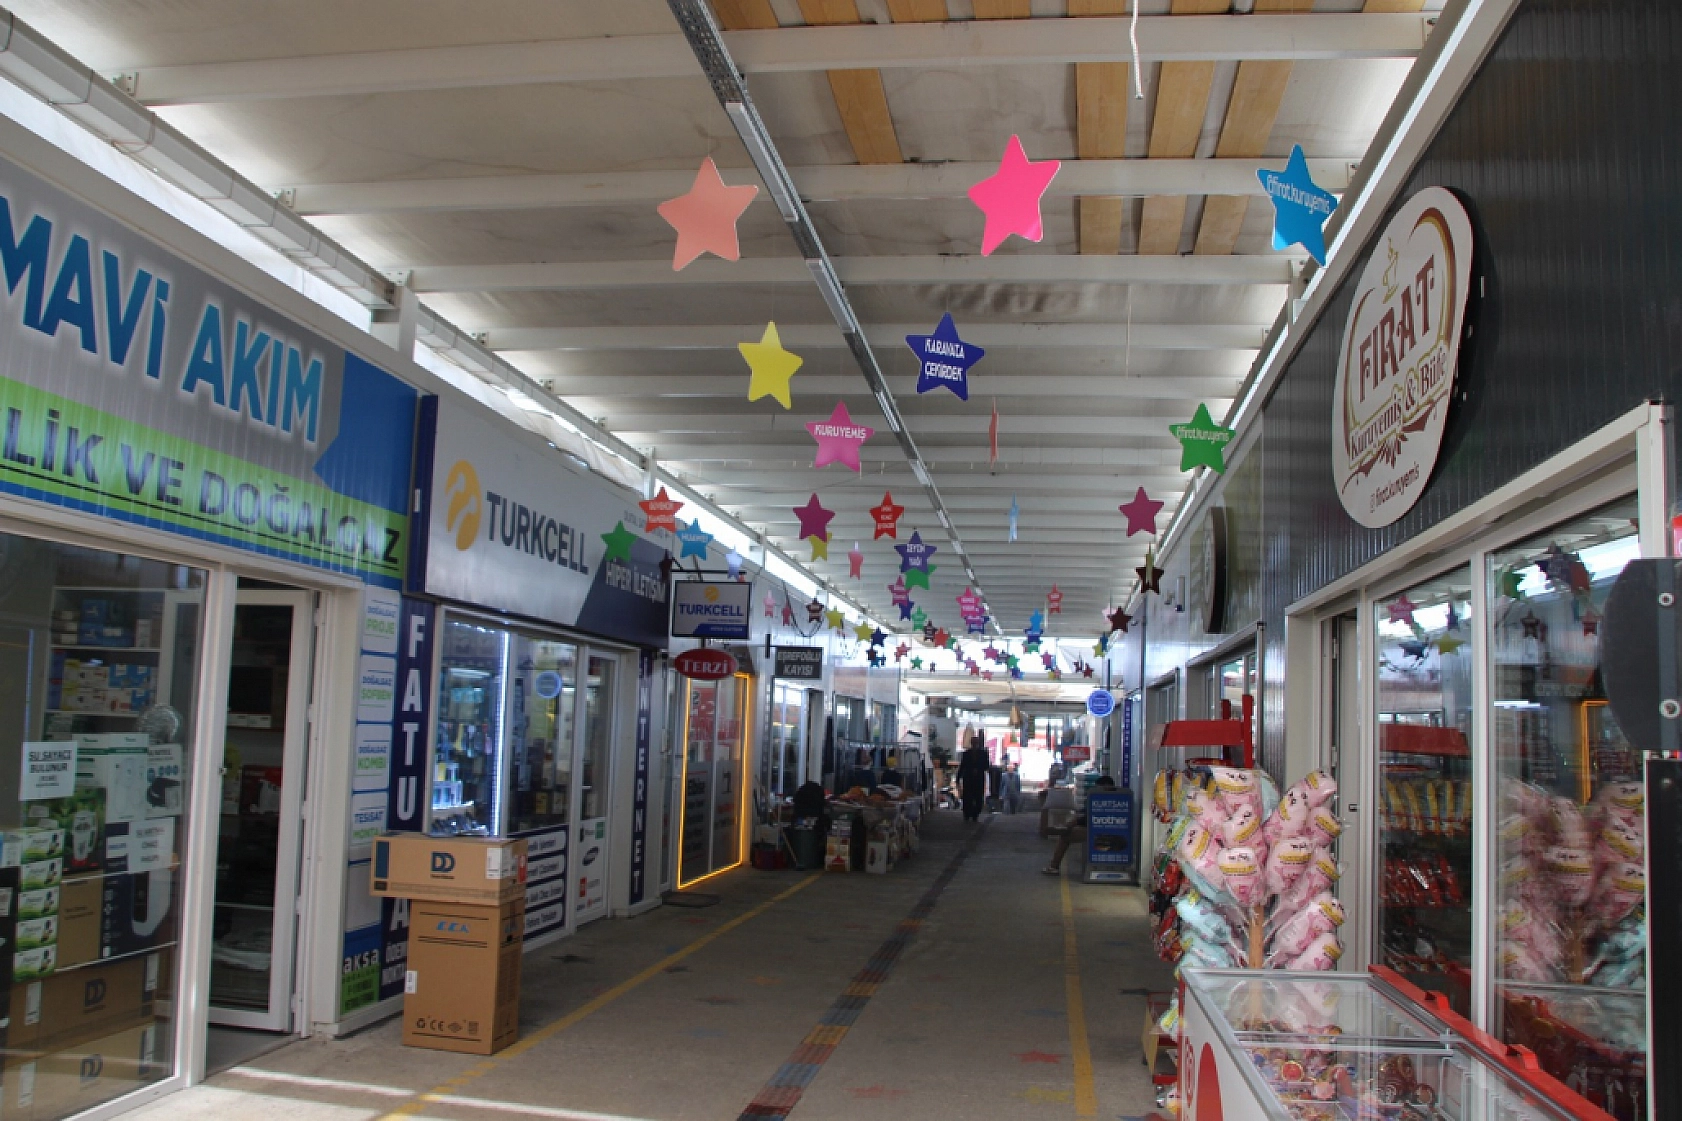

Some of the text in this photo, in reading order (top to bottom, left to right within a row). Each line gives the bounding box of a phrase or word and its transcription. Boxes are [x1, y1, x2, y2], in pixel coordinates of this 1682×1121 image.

[0, 196, 323, 443] MAVİ AKIM
[1360, 254, 1434, 402] FIRAT
[815, 424, 866, 441] KURUYEMİŞ
[121, 442, 184, 507] VE
[200, 470, 400, 564] DOĞALGAZ
[487, 492, 589, 575] TURKCELL
[679, 604, 744, 617] TURKCELL
[367, 619, 395, 635] PROJE
[682, 659, 727, 674] TERZİ
[28, 751, 39, 761] SU
[30, 763, 68, 774] BULUNUR
[1092, 816, 1127, 825] brother
[344, 949, 379, 973] aksa
